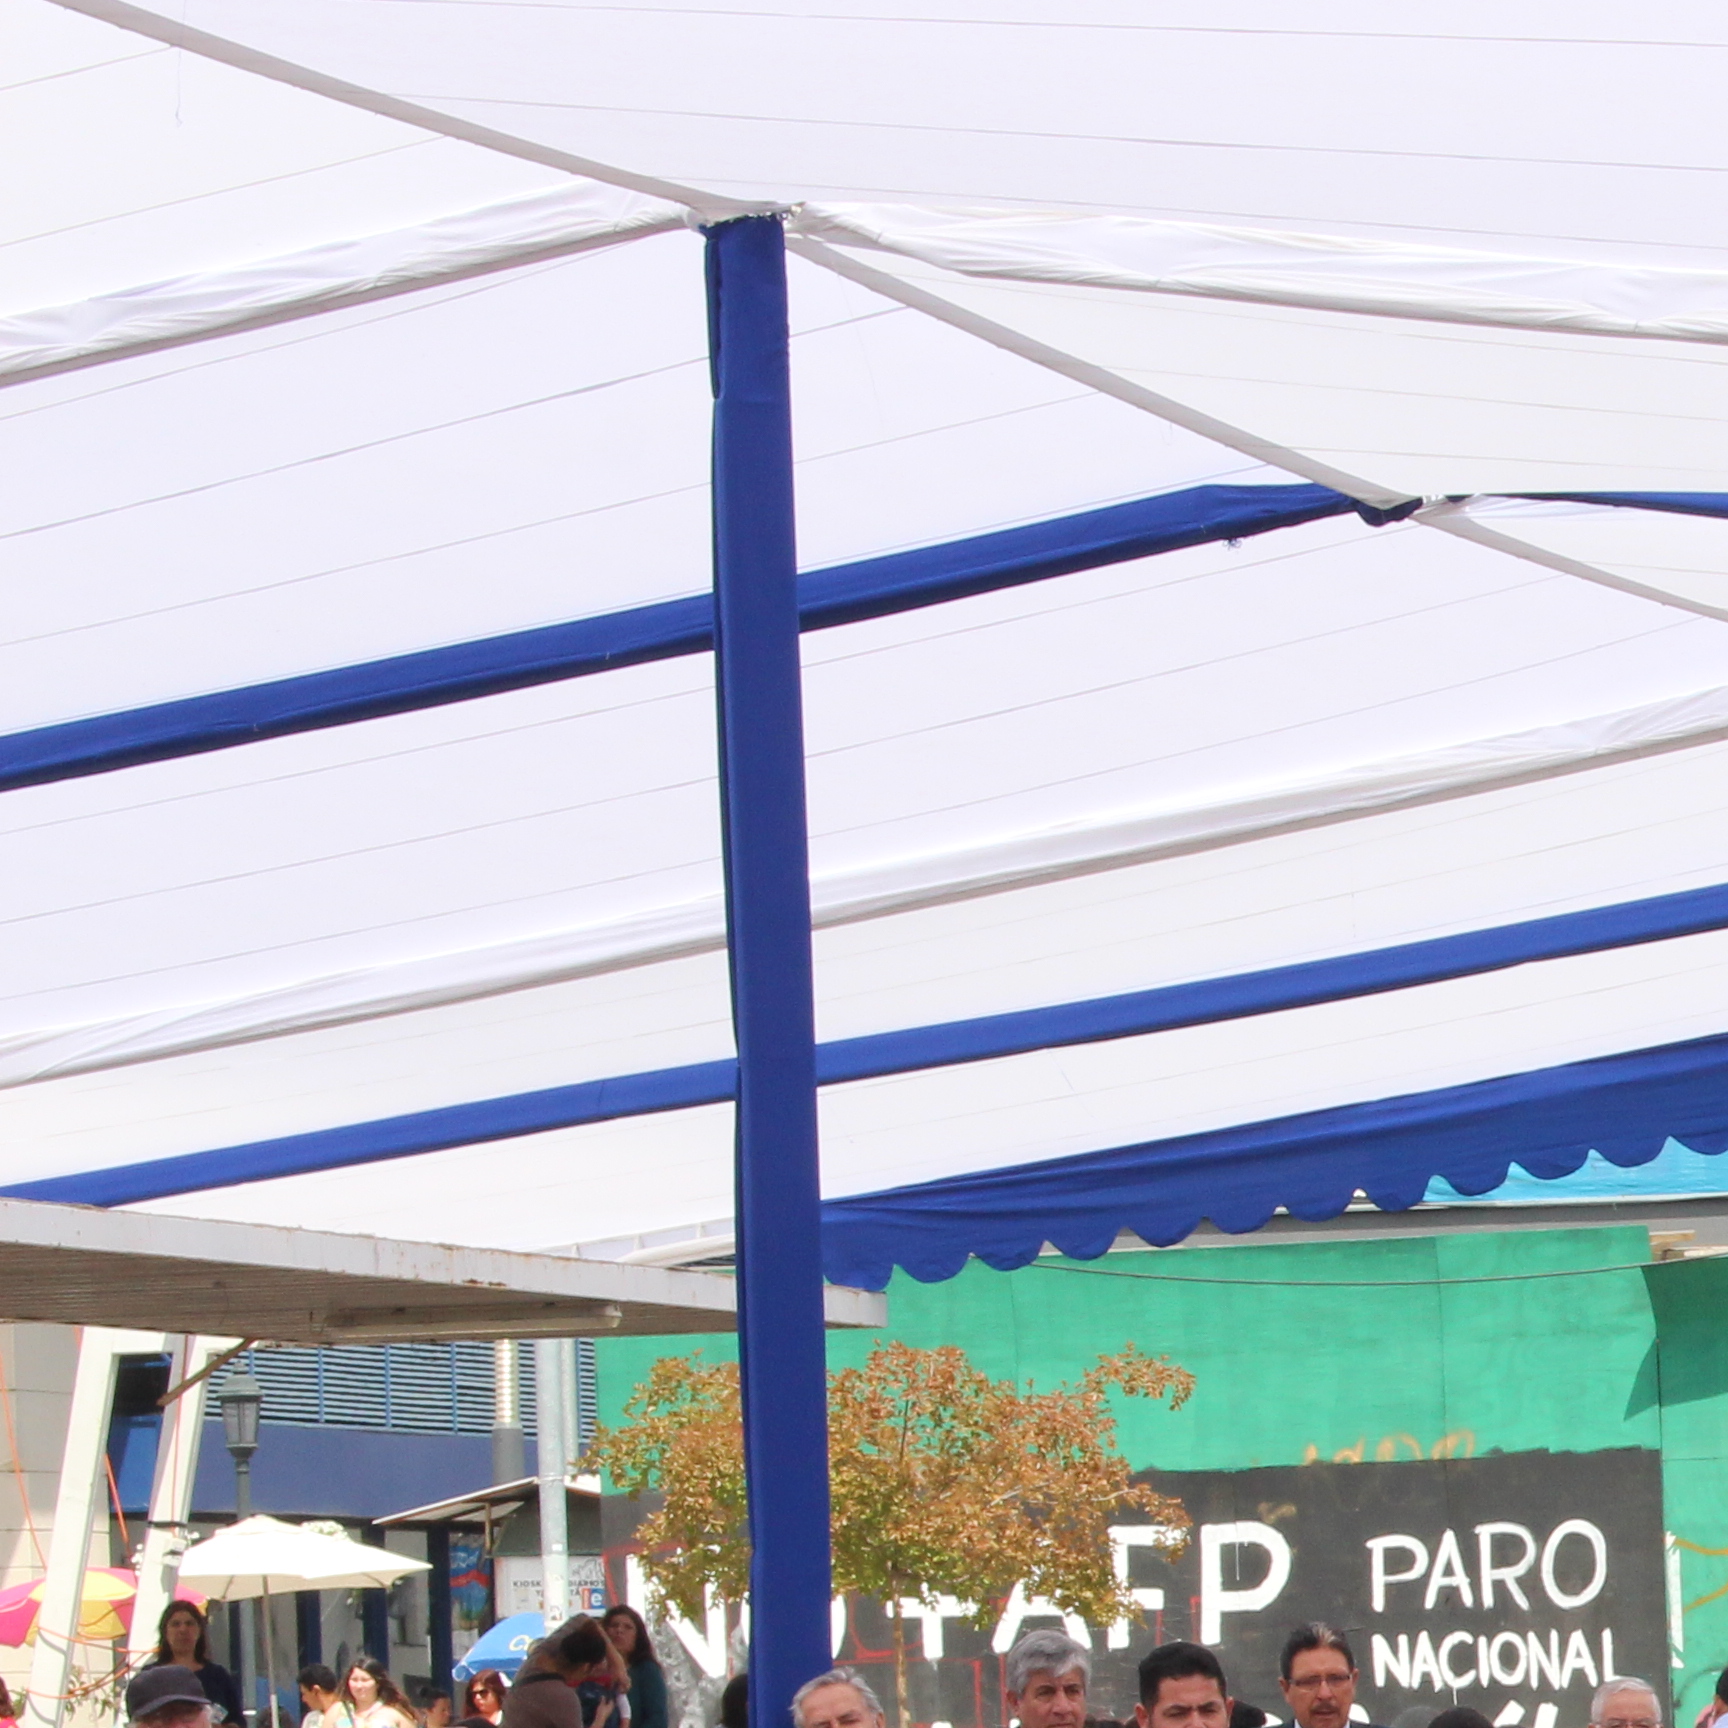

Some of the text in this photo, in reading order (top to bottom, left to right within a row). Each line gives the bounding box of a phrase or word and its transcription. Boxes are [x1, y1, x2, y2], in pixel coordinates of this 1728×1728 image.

[991, 1520, 1292, 1654] AFP
[1365, 1518, 1607, 1612] PARO
[1371, 1627, 1623, 1692] NACIONAL
